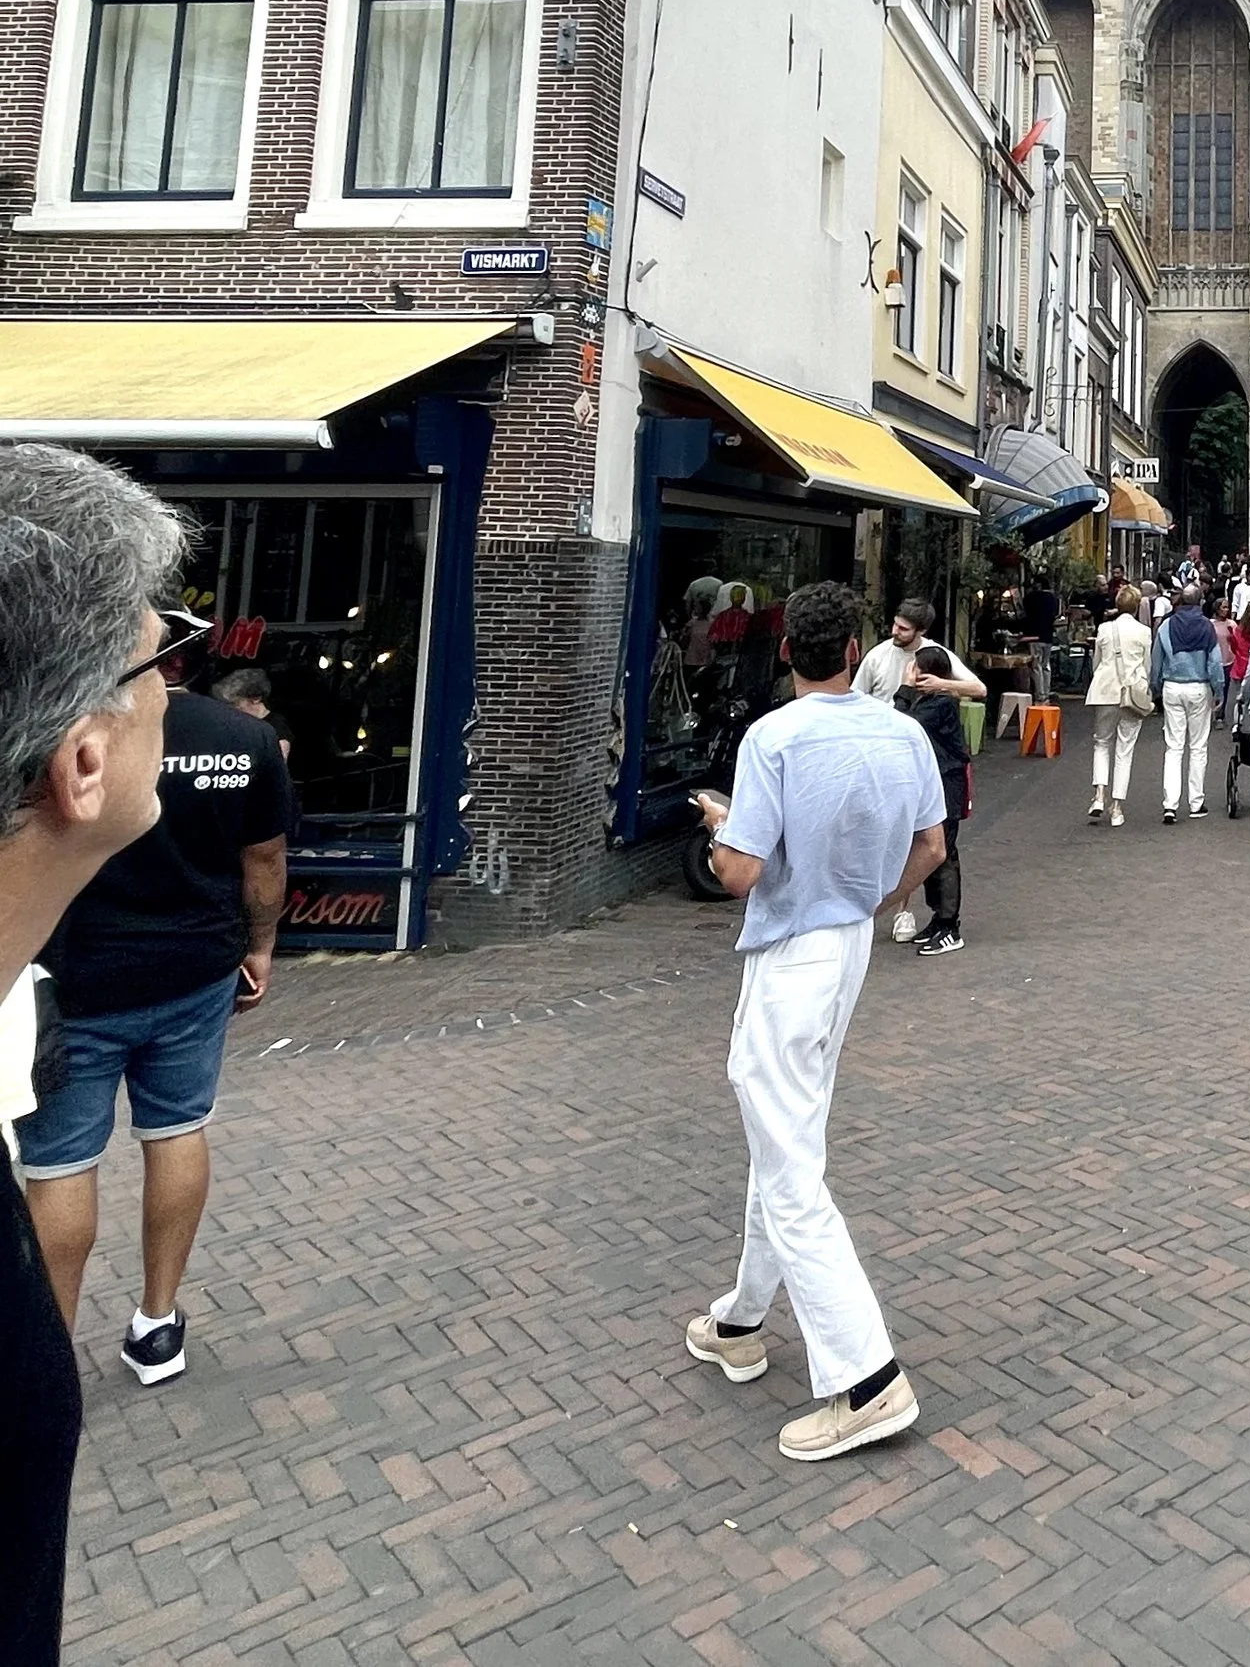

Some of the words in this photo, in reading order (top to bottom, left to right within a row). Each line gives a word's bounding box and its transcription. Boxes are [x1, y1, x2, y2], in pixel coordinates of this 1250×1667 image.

[470, 253, 540, 269] VISMARKT
[1136, 464, 1157, 478] IPA
[280, 888, 386, 925] rsom
